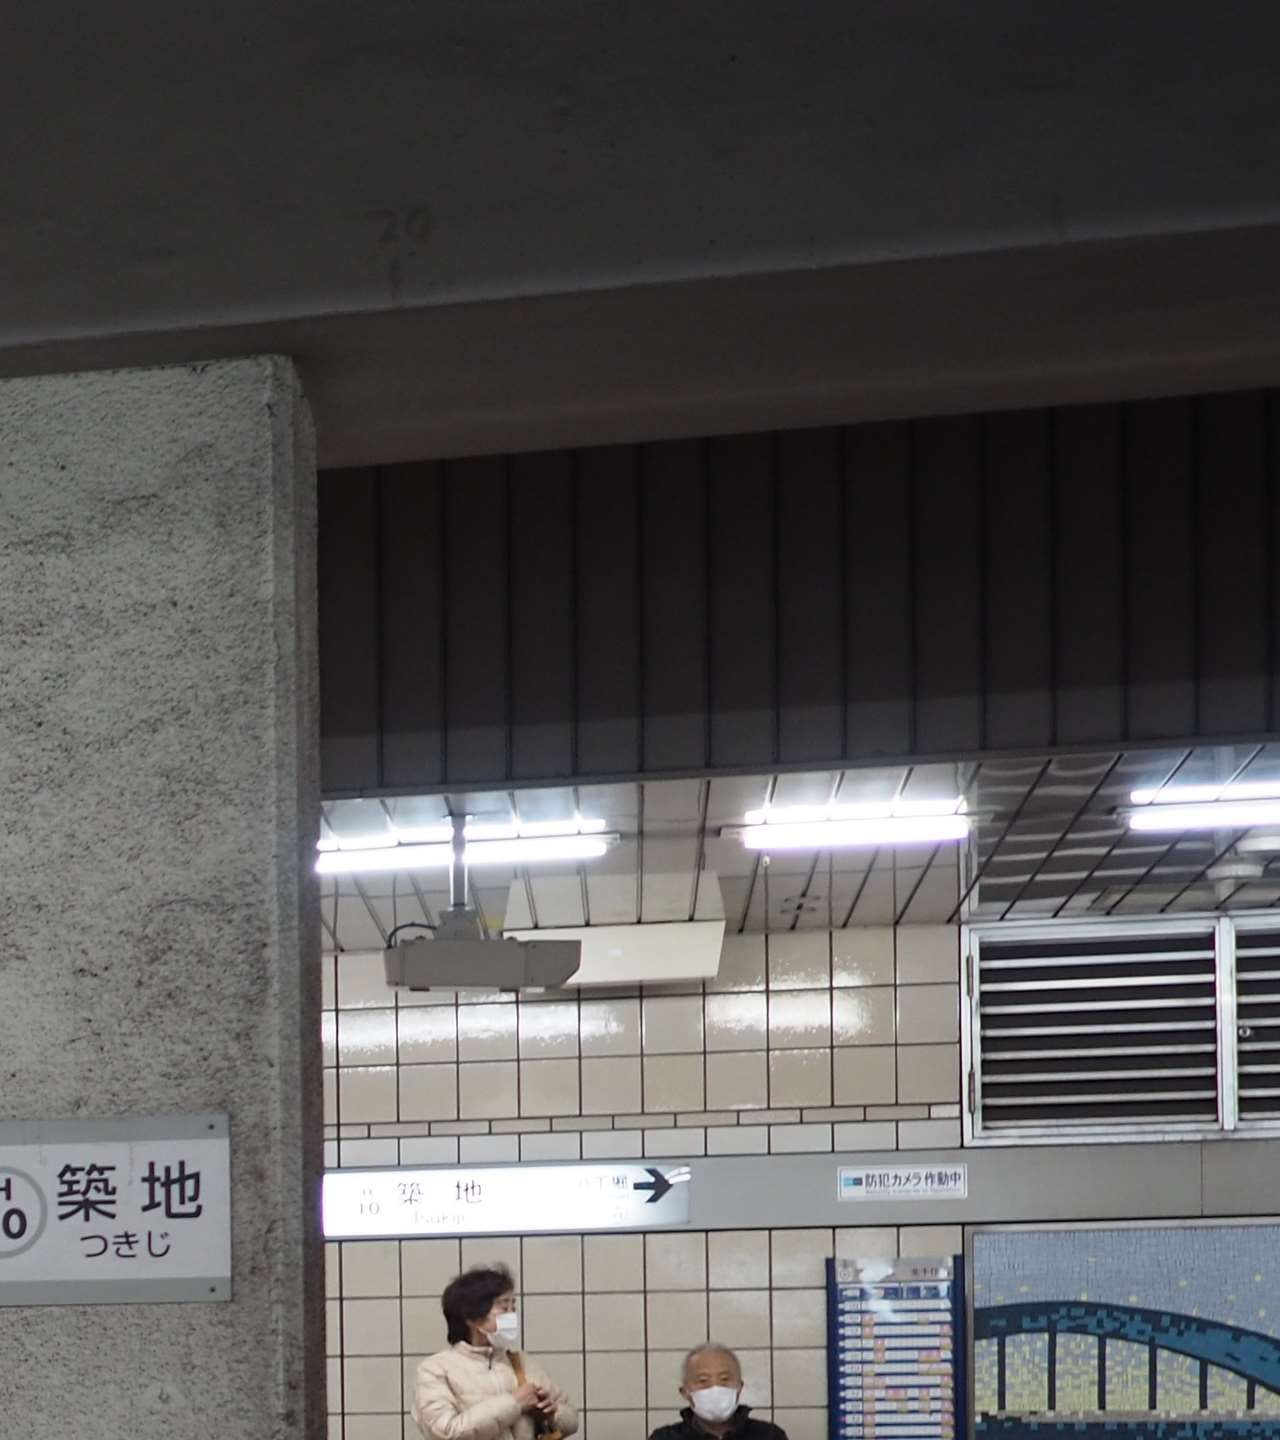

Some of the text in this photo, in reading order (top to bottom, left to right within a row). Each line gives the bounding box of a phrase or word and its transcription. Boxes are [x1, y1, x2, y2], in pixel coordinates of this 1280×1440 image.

[57, 1160, 203, 1223] 築地
[865, 1171, 961, 1188] 防犯カメラ作動中
[80, 1230, 171, 1258] つきじ
